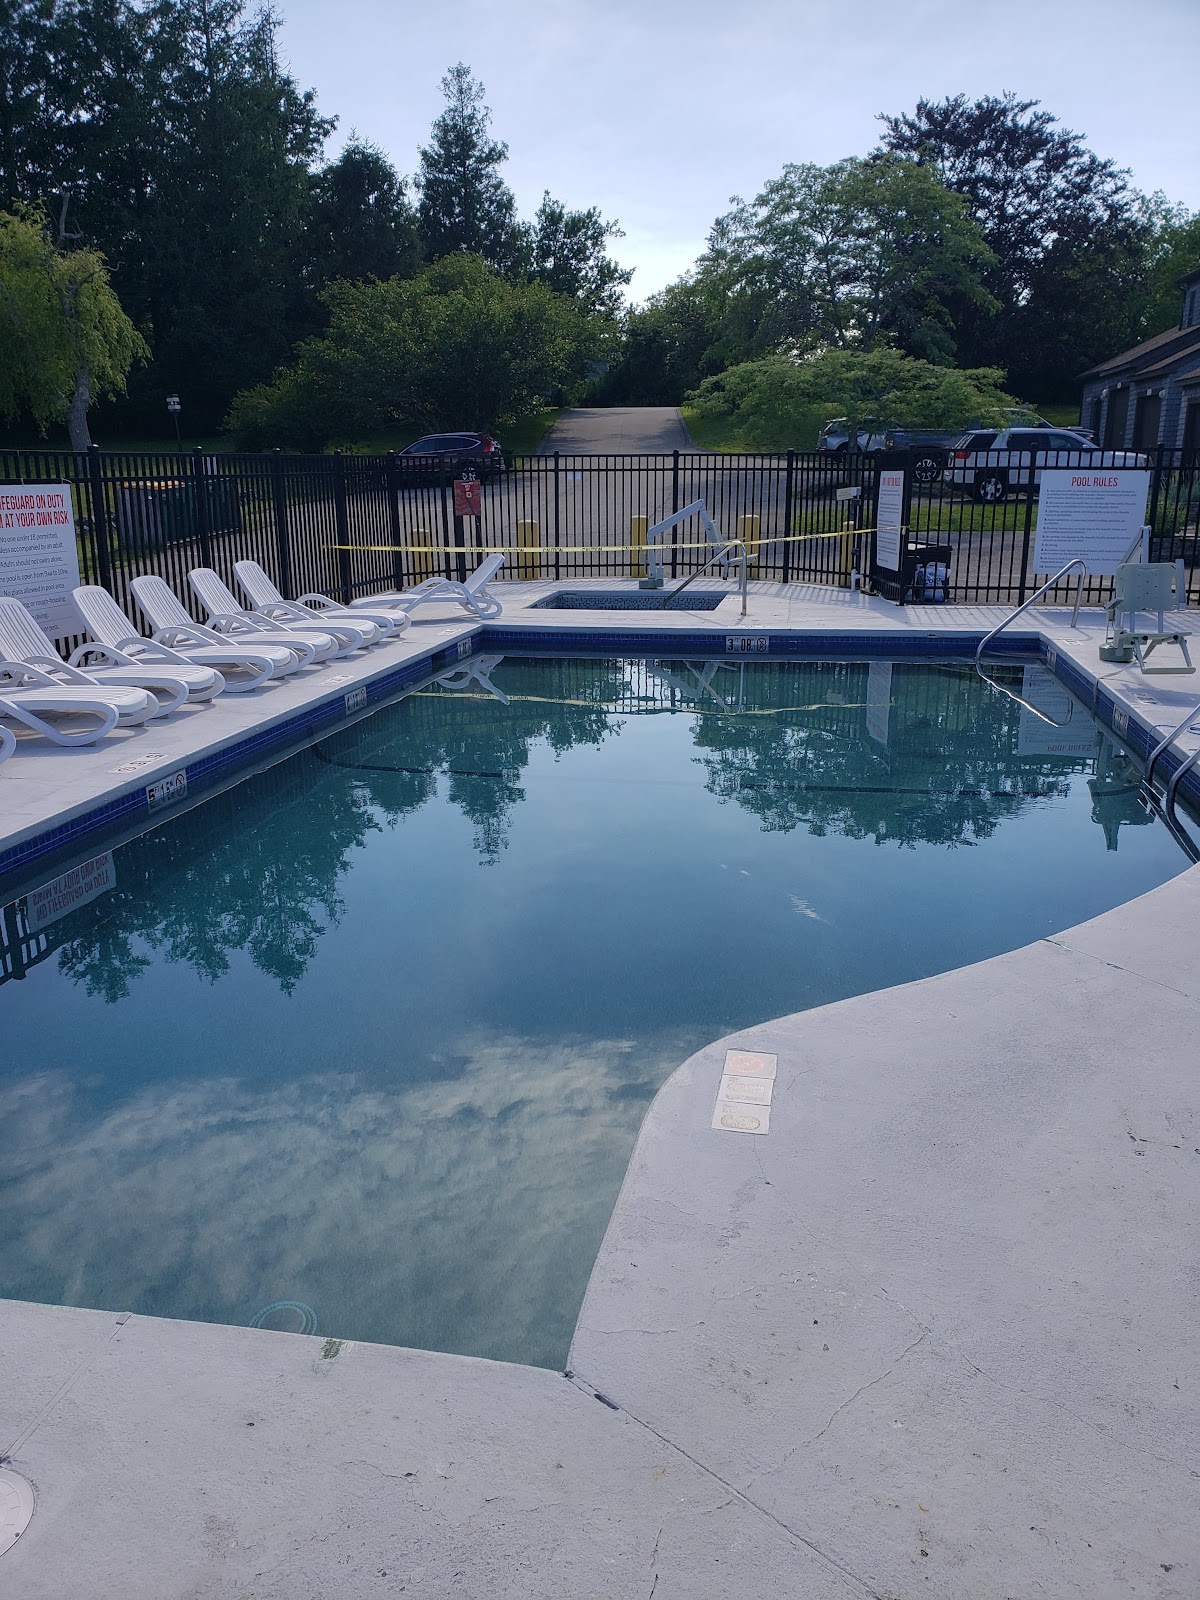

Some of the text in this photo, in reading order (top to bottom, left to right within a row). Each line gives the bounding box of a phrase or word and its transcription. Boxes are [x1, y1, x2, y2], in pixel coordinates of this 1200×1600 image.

[1071, 477, 1119, 487] POOL RULES
[36, 494, 46, 509] ON
[47, 493, 64, 509] DUTY
[5, 513, 14, 529] AT
[15, 512, 36, 528] YOUR
[36, 511, 53, 527] OWN
[53, 510, 69, 525] RISK
[0, 546, 11, 554] less
